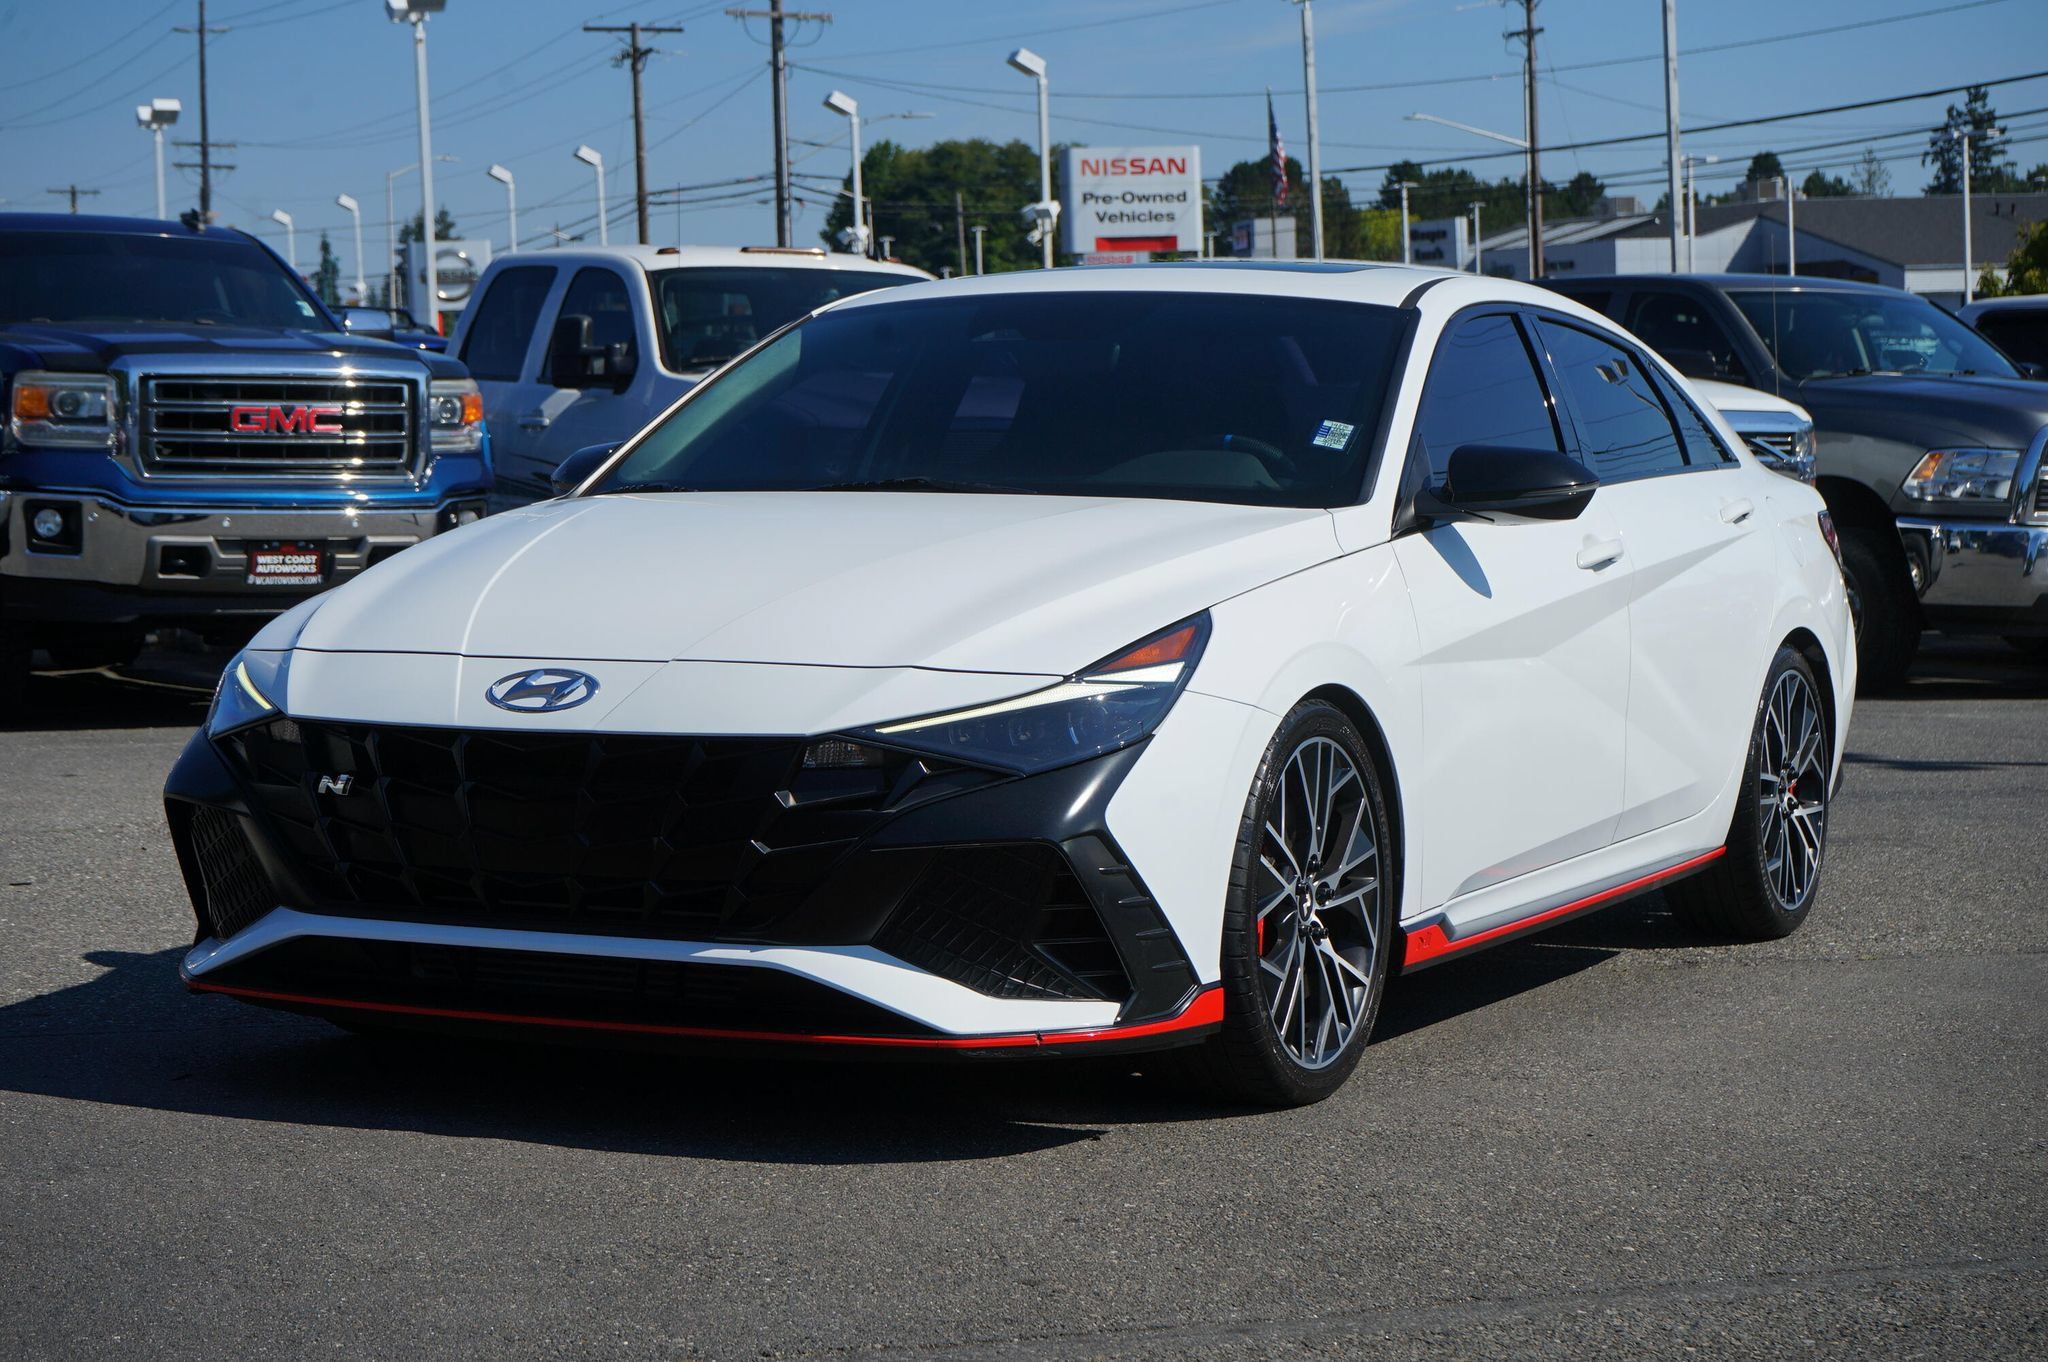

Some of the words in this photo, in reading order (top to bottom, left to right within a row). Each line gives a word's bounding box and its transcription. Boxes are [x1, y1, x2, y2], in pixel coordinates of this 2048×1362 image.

[1081, 158, 1186, 176] NISSAN
[1082, 190, 1187, 205] Pre-Owned
[1095, 210, 1176, 223] Vehicles
[231, 406, 344, 432] GMC
[257, 555, 284, 564] WEST
[284, 555, 317, 564] COAST
[256, 564, 317, 573] AUTOWORKS
